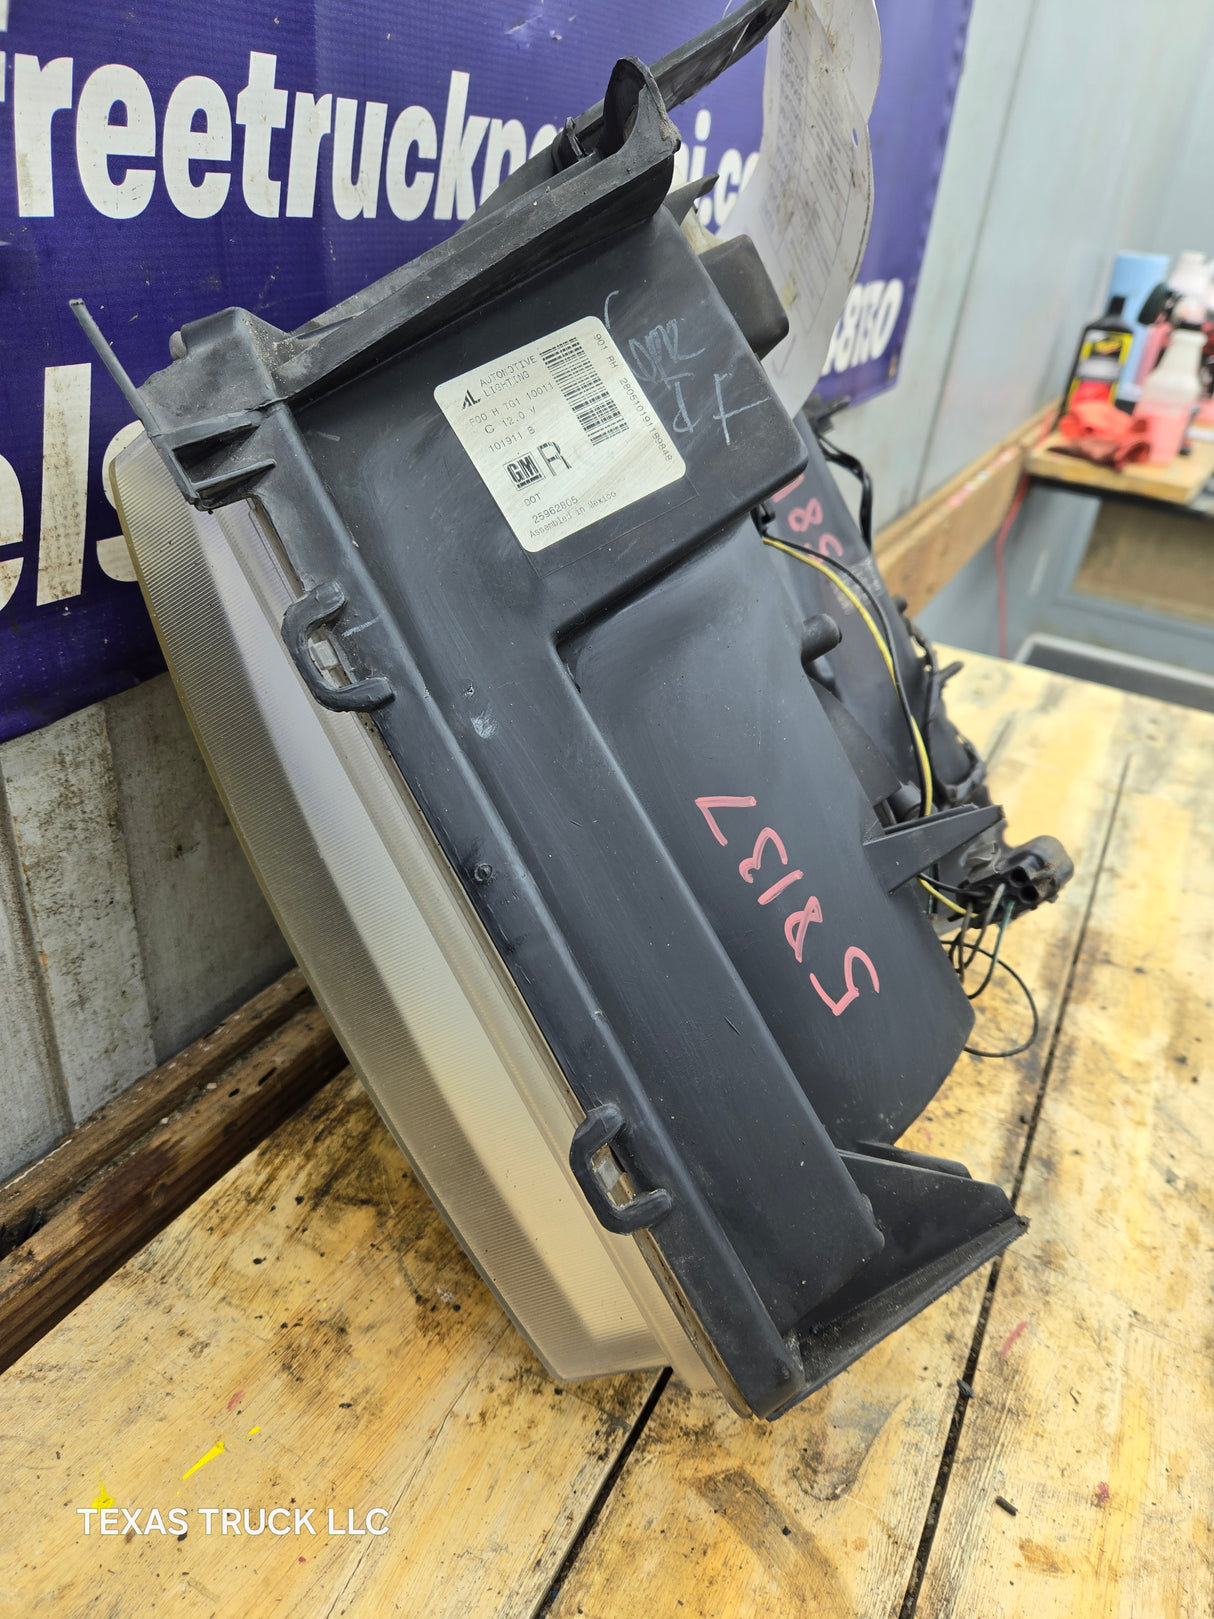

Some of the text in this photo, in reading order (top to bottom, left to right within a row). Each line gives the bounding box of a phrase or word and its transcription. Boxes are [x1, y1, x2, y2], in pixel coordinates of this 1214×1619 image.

[591, 332, 610, 353] 901
[604, 354, 620, 369] RH
[478, 354, 538, 388] AUTOMOTIVE
[482, 370, 531, 398] LIGHTING
[490, 405, 501, 418] H
[524, 380, 555, 400] 10011
[483, 422, 496, 435] C
[501, 409, 527, 428] 12.0
[487, 430, 524, 454] 101911
[535, 438, 573, 477] R
[504, 454, 543, 490] GM
[523, 492, 543, 507] DOT
[528, 487, 617, 540] Assembled in Mexico
[530, 494, 579, 524] 25962805
